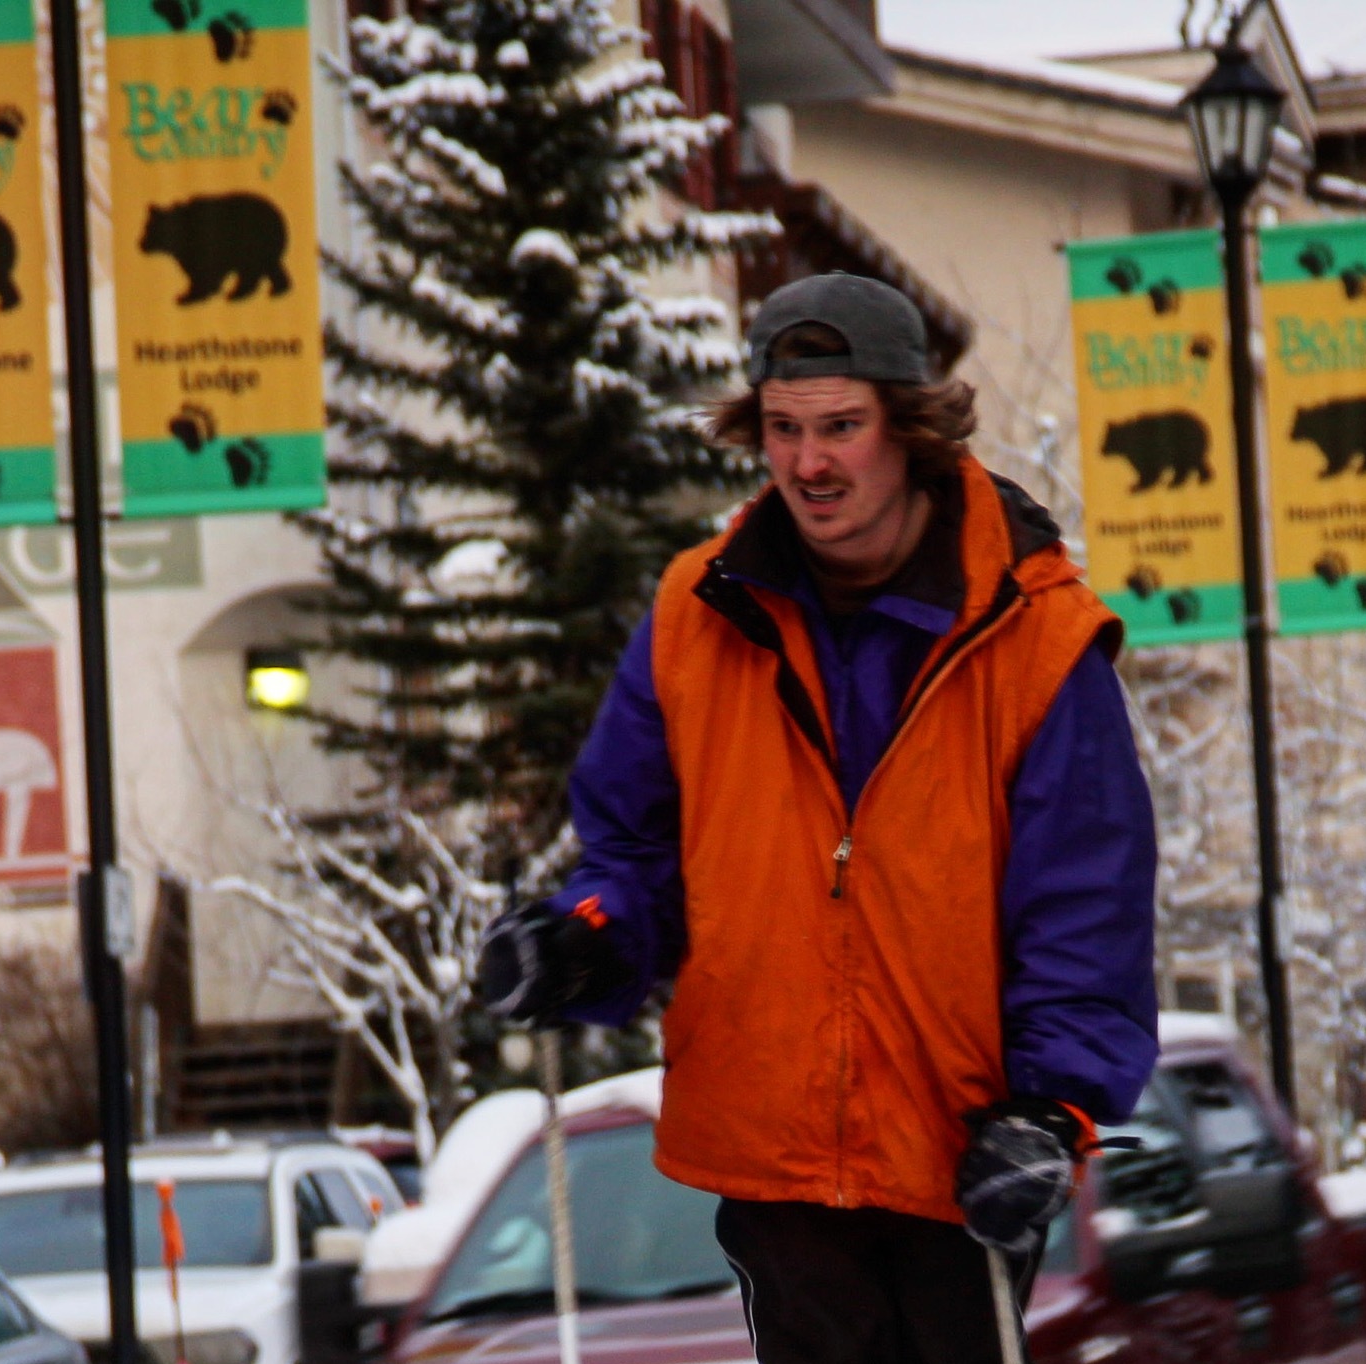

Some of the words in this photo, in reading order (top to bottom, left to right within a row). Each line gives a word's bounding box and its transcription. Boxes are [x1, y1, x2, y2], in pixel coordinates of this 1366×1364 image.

[122, 81, 264, 137] Bear
[134, 335, 302, 364] Hearthstone
[179, 367, 260, 396] Lodge
